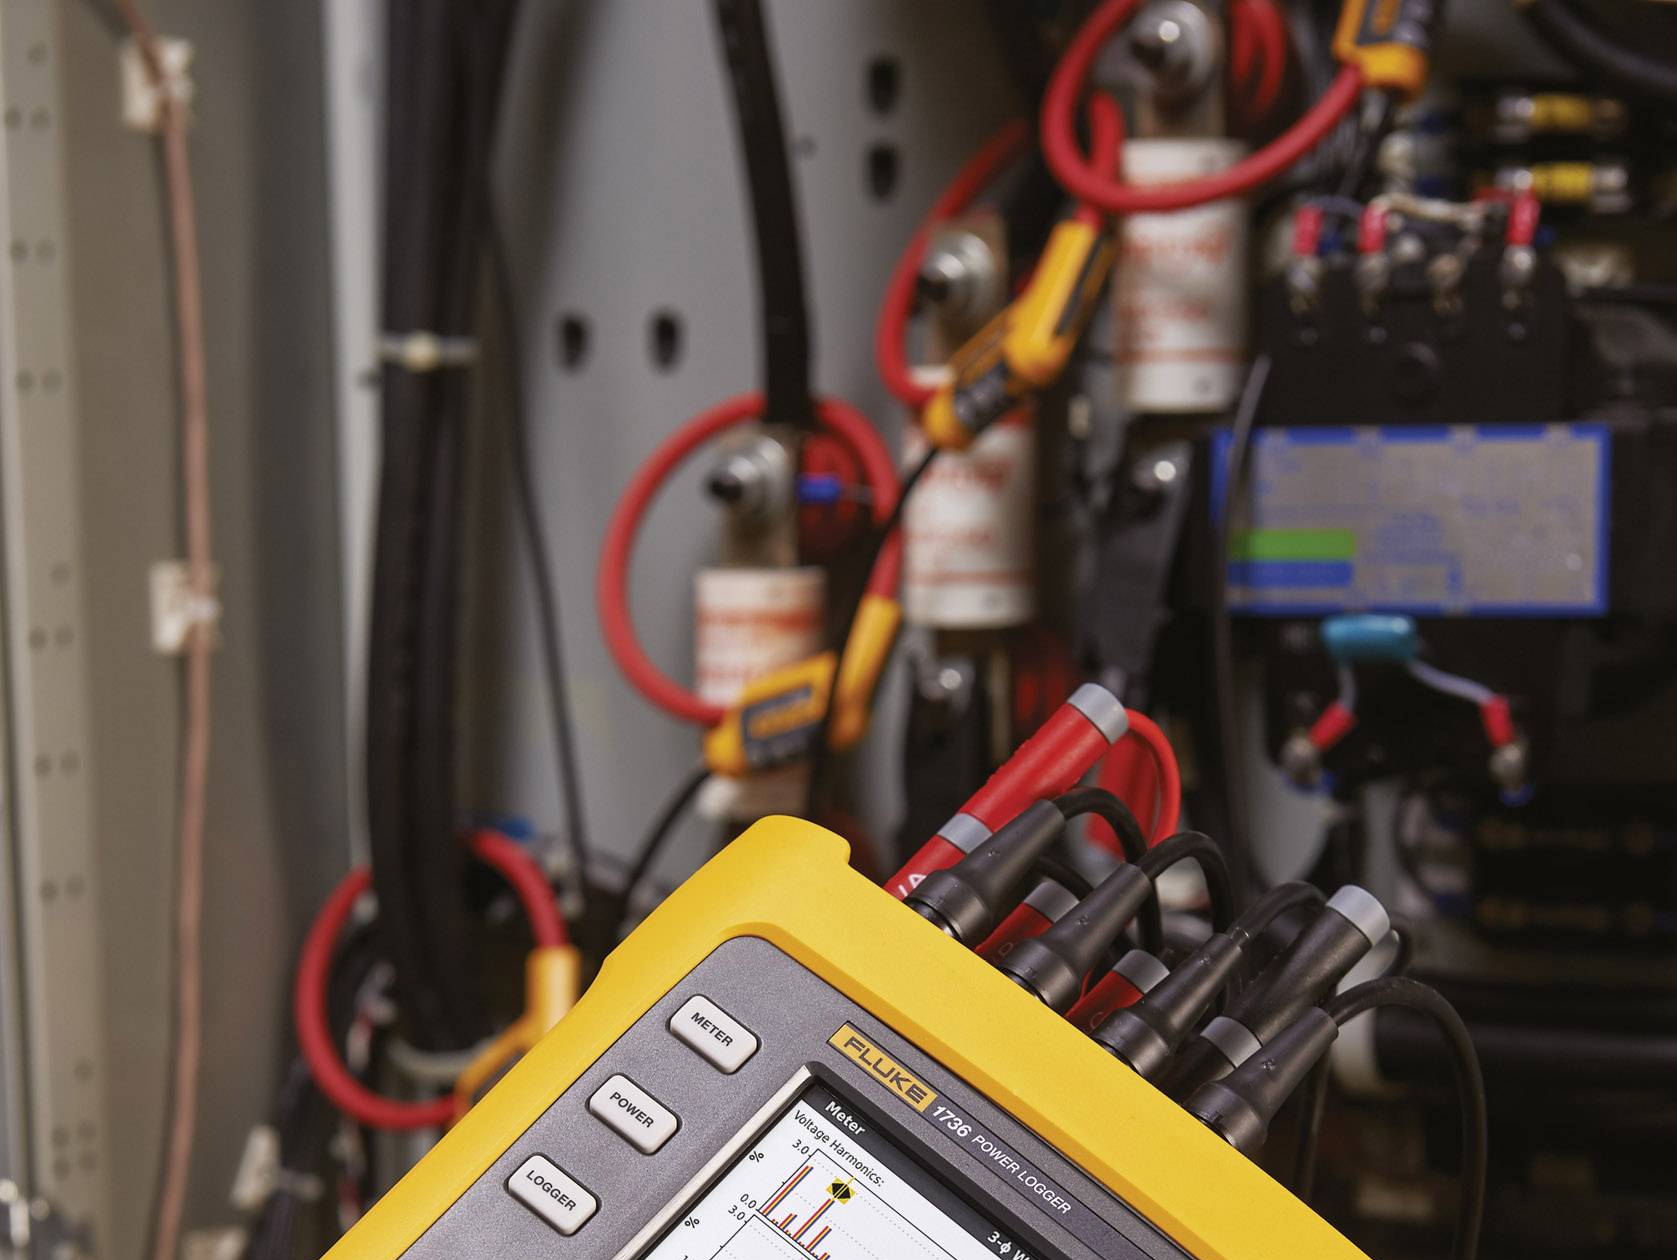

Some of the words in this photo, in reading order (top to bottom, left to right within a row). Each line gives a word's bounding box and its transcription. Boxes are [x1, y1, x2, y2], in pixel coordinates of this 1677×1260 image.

[691, 1012, 733, 1046] METER
[844, 1036, 928, 1104] FLUKE
[610, 1092, 654, 1128] POWER
[825, 1101, 866, 1135] Meter
[748, 1150, 764, 1162] %
[792, 1139, 810, 1155] 3.0
[794, 1110, 830, 1143] Voltage
[829, 1139, 885, 1187] Harmonics:
[932, 1105, 972, 1137] 1736
[971, 1135, 1020, 1173] POWER
[1017, 1170, 1072, 1214] LOGGER
[526, 1170, 576, 1211] LOGGER
[739, 1193, 757, 1209] 0.0
[684, 1217, 700, 1229] %
[728, 1205, 746, 1220] 3.0
